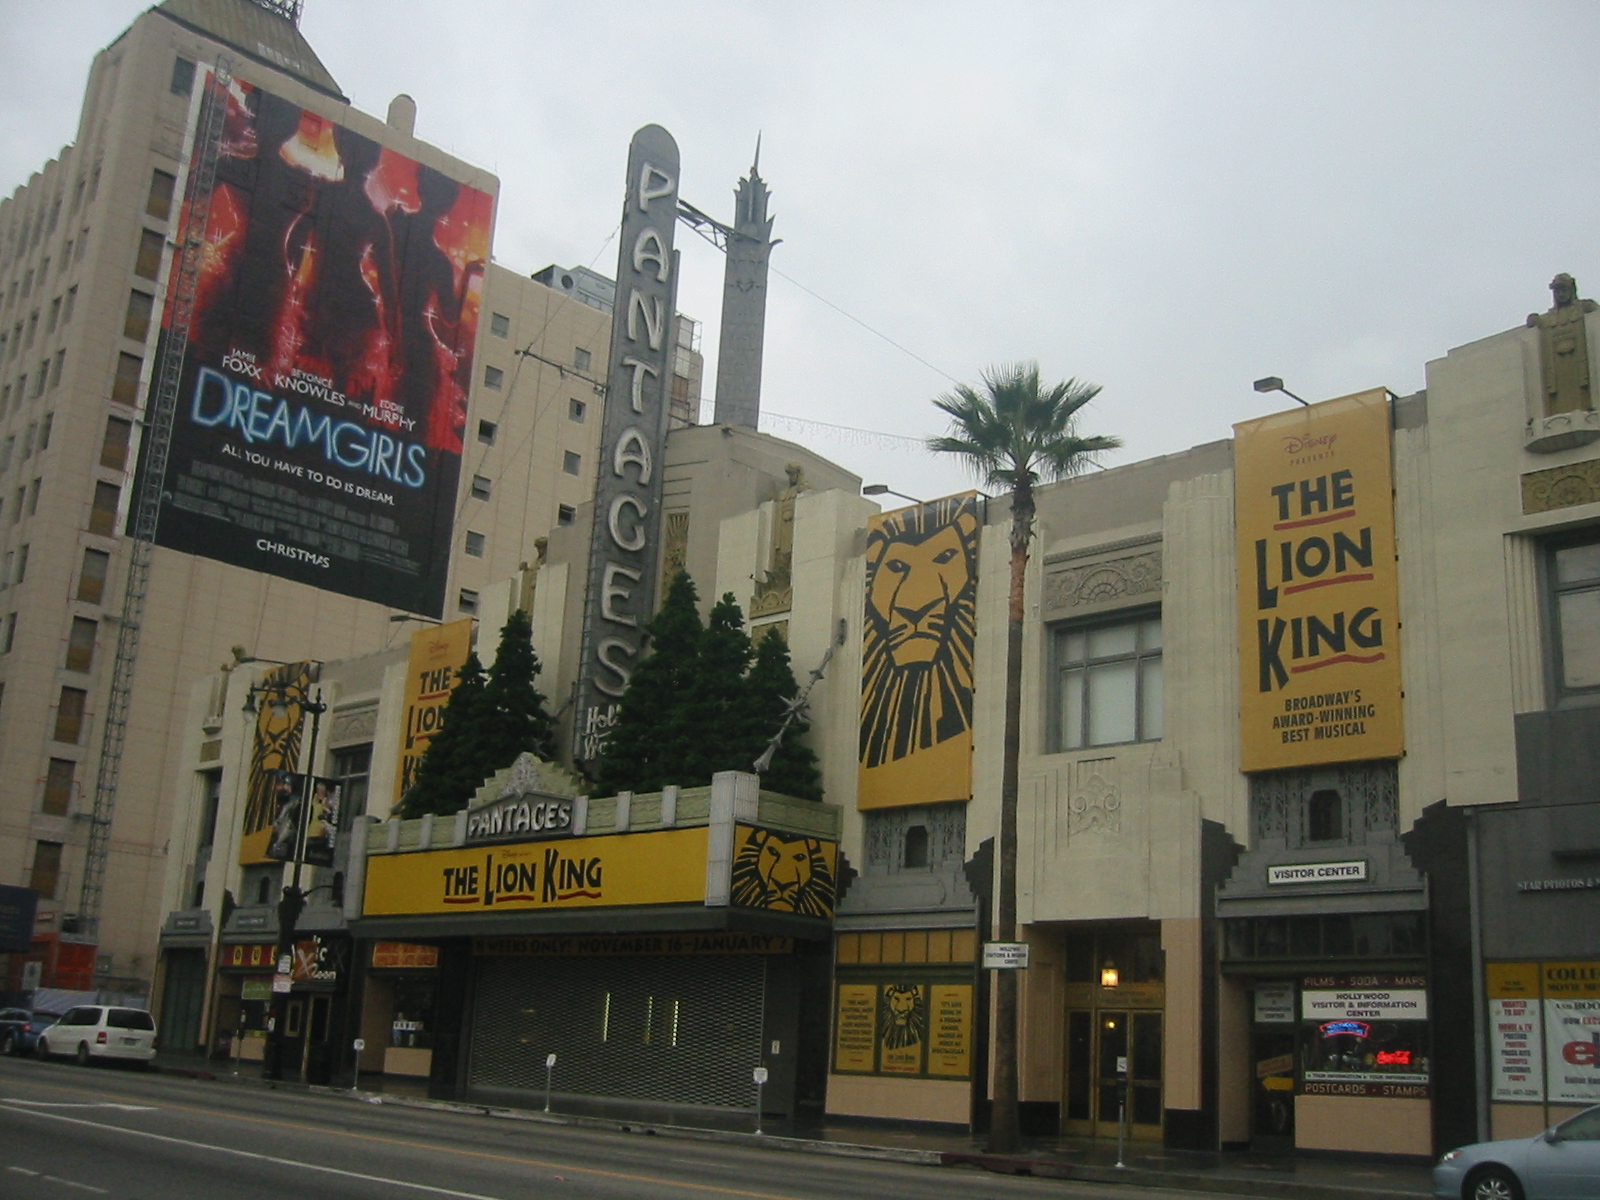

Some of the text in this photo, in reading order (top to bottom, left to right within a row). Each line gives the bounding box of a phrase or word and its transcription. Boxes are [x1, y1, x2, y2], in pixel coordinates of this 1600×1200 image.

[222, 355, 261, 380] FOXX
[275, 374, 346, 407] KNOWLES
[191, 366, 426, 489] DREAMGIRLS
[363, 404, 416, 432] MURPHY
[594, 162, 675, 698] PANTAGES
[1290, 451, 1335, 466] PRESENTS
[245, 450, 270, 468] YOU
[274, 459, 304, 477] HAVE
[307, 469, 323, 483] TO
[326, 475, 342, 489] DO
[344, 481, 354, 494] IS
[356, 485, 395, 506] DREAM.
[1271, 468, 1355, 521] THE
[256, 539, 331, 569] CHRISTMAS
[1255, 526, 1374, 610] LION
[1257, 606, 1383, 693] KING
[420, 666, 451, 694] THE
[1285, 689, 1362, 712] BROADWAY'S
[1272, 704, 1376, 730] AWARD-WINNING
[1281, 721, 1367, 744] BEST MUSICAL
[468, 802, 572, 838] PANTAGES
[443, 848, 602, 905] THE LION KING
[1273, 865, 1360, 880] VISITOR CENTER
[578, 935, 663, 952] NOVEMBER
[1304, 976, 1426, 986] FILMS SODA MAPS
[1311, 1001, 1417, 1009] VISITOR & INFORMATION
[1305, 1083, 1427, 1095] POSTCARDS STAMPS
